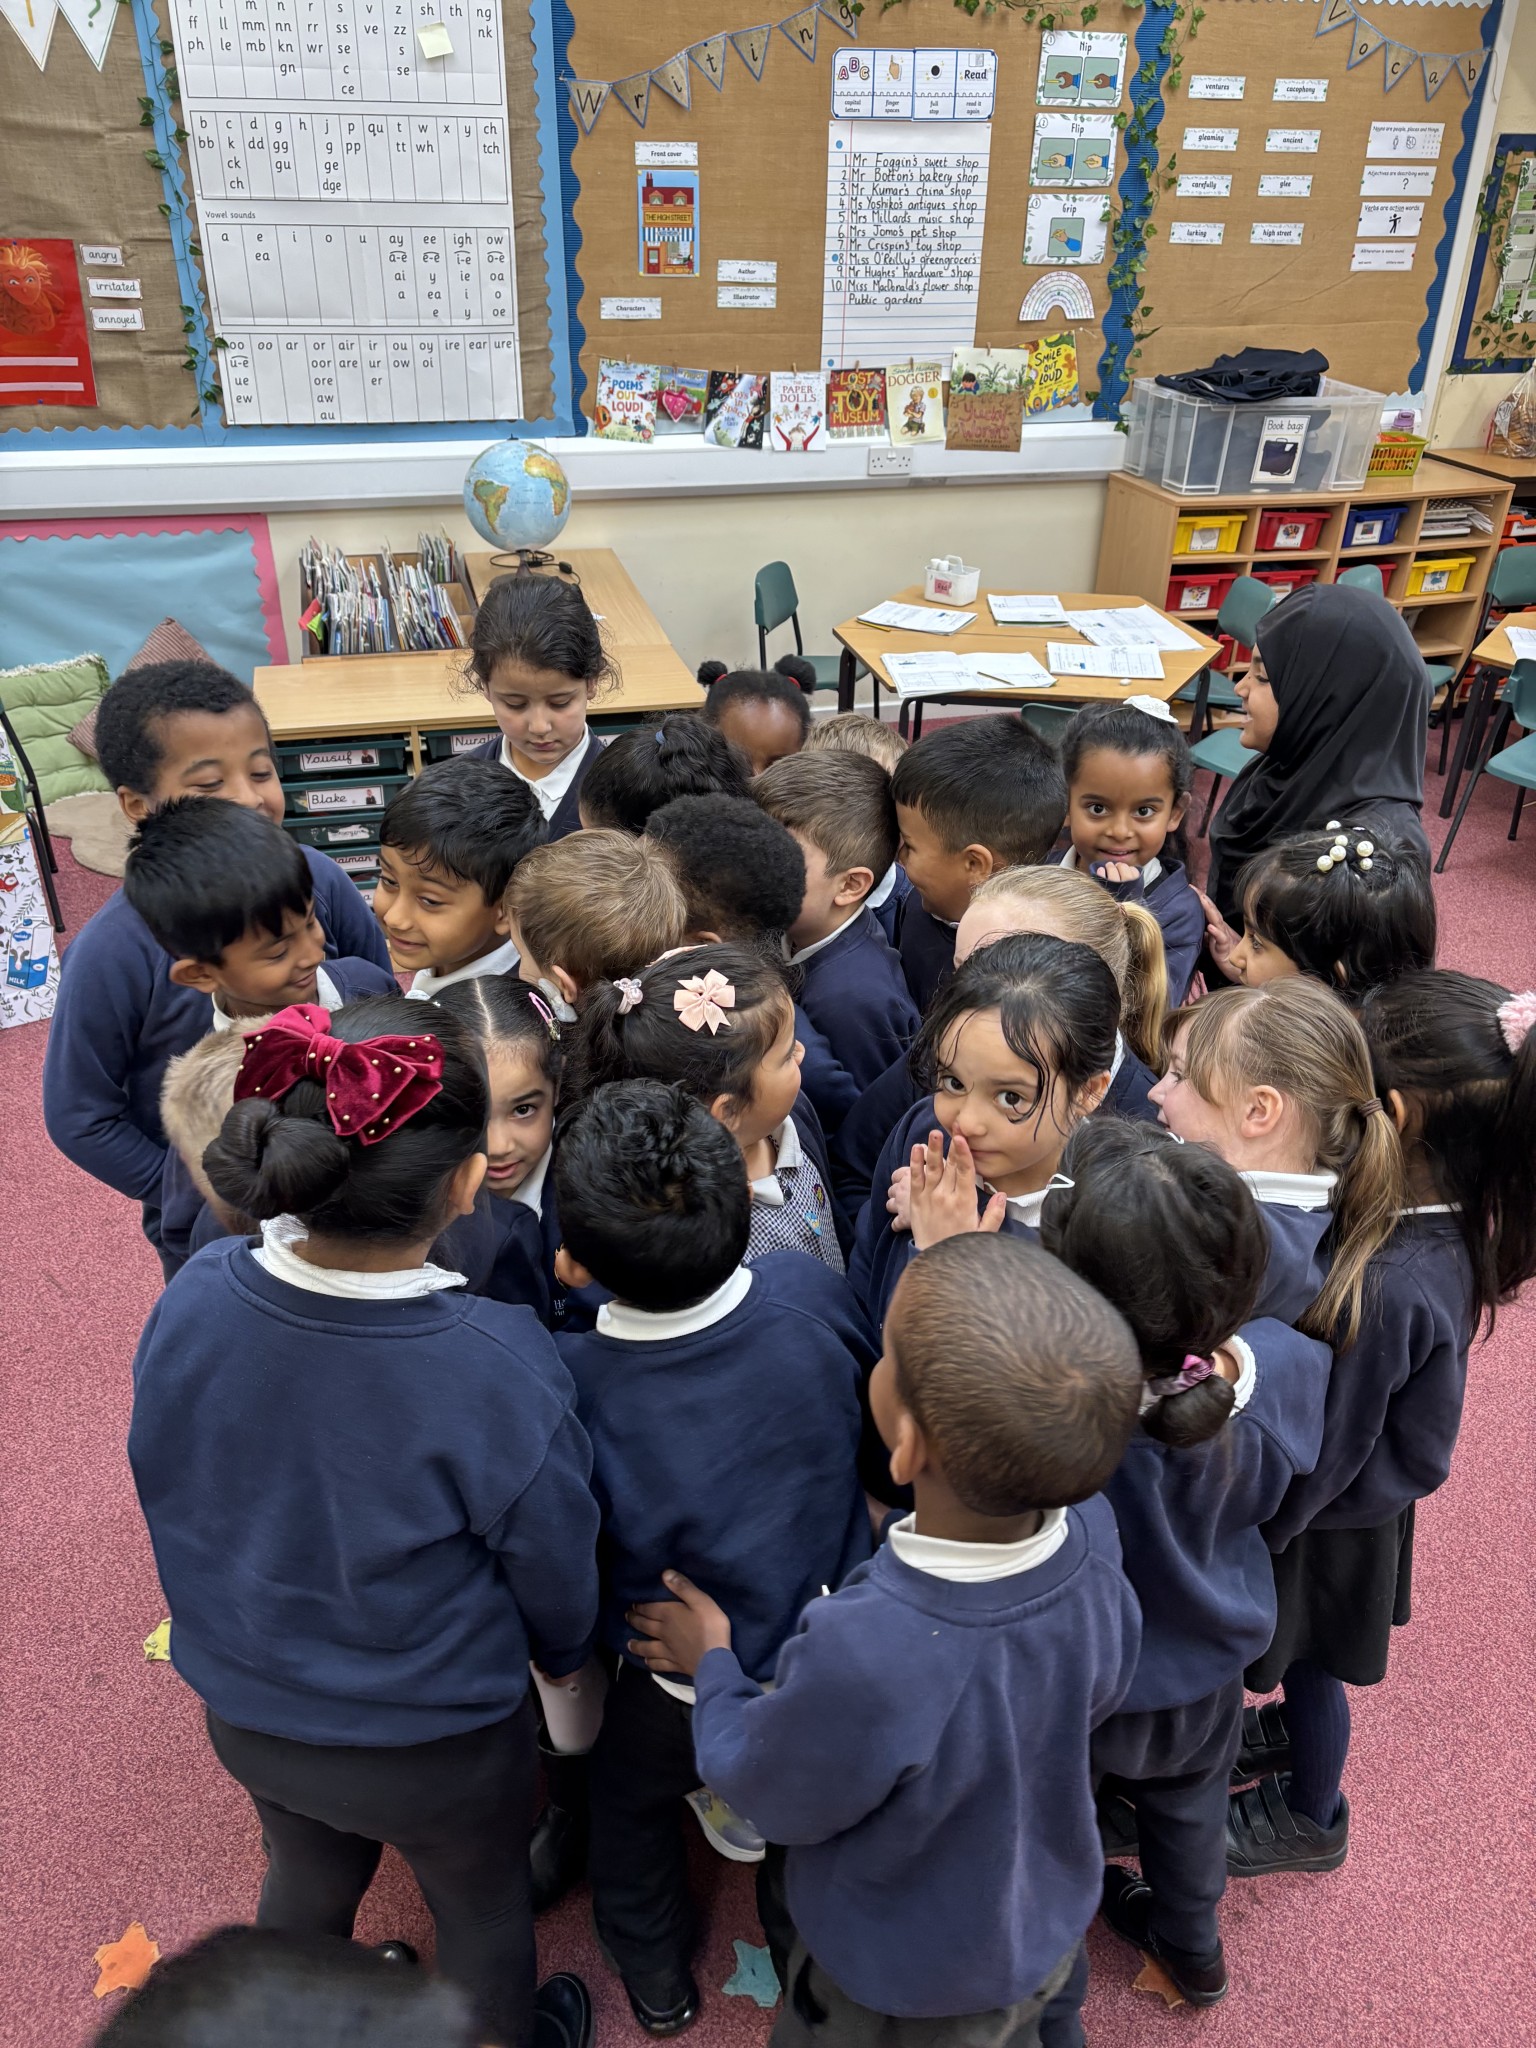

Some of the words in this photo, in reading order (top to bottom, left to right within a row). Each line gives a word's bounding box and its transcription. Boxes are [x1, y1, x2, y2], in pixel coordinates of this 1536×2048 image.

[420, 2, 435, 16] sh
[449, 3, 463, 17] th
[476, 8, 492, 22] ng
[188, 15, 198, 29] ff
[219, 16, 229, 31] ll
[241, 21, 266, 32] mm
[275, 22, 293, 32] nn
[307, 23, 319, 33] rr
[336, 23, 349, 34] ss
[363, 24, 379, 35] ve
[393, 25, 407, 36] zz
[477, 24, 493, 39] nk
[1080, 42, 1092, 55] Nip
[577, 5, 853, 114] Writing
[964, 69, 987, 80] Read
[1286, 86, 1316, 94] cacophony
[1071, 122, 1084, 137] Flip
[1198, 134, 1225, 142] gleaming
[1282, 136, 1304, 144] ancient
[198, 135, 215, 149] bb
[247, 136, 265, 150] dd
[272, 140, 289, 154] gg
[345, 142, 361, 155] pp
[395, 141, 407, 153] tt
[415, 139, 435, 153] wh
[482, 141, 501, 155] tch
[853, 154, 867, 167] Mr
[876, 153, 918, 171] Foggin's
[924, 157, 948, 168] sweet
[956, 156, 980, 172] shop
[852, 168, 866, 181] Mr
[920, 168, 952, 188] bakery
[957, 169, 978, 186] shop
[1280, 180, 1292, 188] glee
[852, 182, 864, 196] Mr
[872, 182, 909, 196] Kumar's
[916, 182, 944, 196] china
[950, 183, 972, 199] shop
[1192, 181, 1217, 190] carefully
[851, 196, 862, 210] Ms
[866, 196, 903, 210] Yoshiko's
[908, 197, 946, 216] antiques
[952, 197, 978, 215] shop
[1062, 203, 1077, 216] Grip
[205, 210, 228, 218] Vowel
[231, 211, 256, 219] sounds
[646, 214, 656, 222] THE
[656, 214, 670, 222] HIGH
[670, 214, 691, 222] STREET
[850, 210, 867, 224] Mrs
[872, 210, 911, 224] Millard's
[918, 213, 942, 224] music
[950, 211, 974, 230] shop
[850, 225, 866, 237] Mrs
[873, 225, 904, 238] Jomo's
[910, 225, 928, 242] pet
[932, 226, 956, 242] shop
[1186, 229, 1207, 238] lurking
[1262, 229, 1276, 238] high
[388, 235, 404, 248] ay
[423, 235, 437, 245] ee
[453, 233, 472, 248] igh
[486, 236, 504, 245] ow
[850, 239, 862, 250] Mr
[868, 238, 910, 254] Crispin's
[916, 240, 932, 256] toy
[937, 240, 962, 256] shop
[88, 251, 118, 263] angry
[254, 252, 271, 262] ea
[849, 252, 870, 265] Miss
[874, 252, 916, 270] O'Reilly's
[848, 266, 860, 278] Mr
[902, 266, 944, 278] hardware
[951, 266, 974, 282] shop
[96, 281, 136, 292] irritated
[848, 279, 868, 292] Miss
[872, 280, 920, 293] MacDonald's
[922, 279, 950, 296] flower
[954, 279, 974, 294] shop
[616, 304, 646, 312] Characters
[848, 293, 877, 305] Public
[884, 293, 923, 310] gardens
[98, 314, 137, 328] annoyed
[228, 342, 243, 351] oo
[257, 341, 273, 351] oo
[285, 341, 299, 351] ar
[312, 341, 326, 351] or
[338, 339, 355, 351] air
[368, 339, 378, 351] ir
[392, 342, 408, 351] ou
[419, 342, 434, 354] oy
[445, 339, 460, 351] ire
[468, 341, 488, 350] ear
[494, 340, 512, 349] ure
[1044, 360, 1058, 372] OUT
[840, 371, 875, 386] LOST
[888, 370, 940, 388] DOGGER
[1038, 368, 1063, 386] LOUD
[612, 380, 644, 391] POEMS
[782, 385, 814, 394] PAPER
[616, 391, 636, 400] OUT
[780, 394, 816, 402] DOLLS
[832, 389, 878, 412] TOY
[612, 402, 644, 412] LOUD!
[833, 412, 879, 424] MUSEUM
[1268, 420, 1285, 430] Book
[1287, 420, 1304, 434] bags
[304, 751, 352, 764] Yousuf
[311, 794, 348, 805] Blake
[8, 976, 25, 986] MILK
